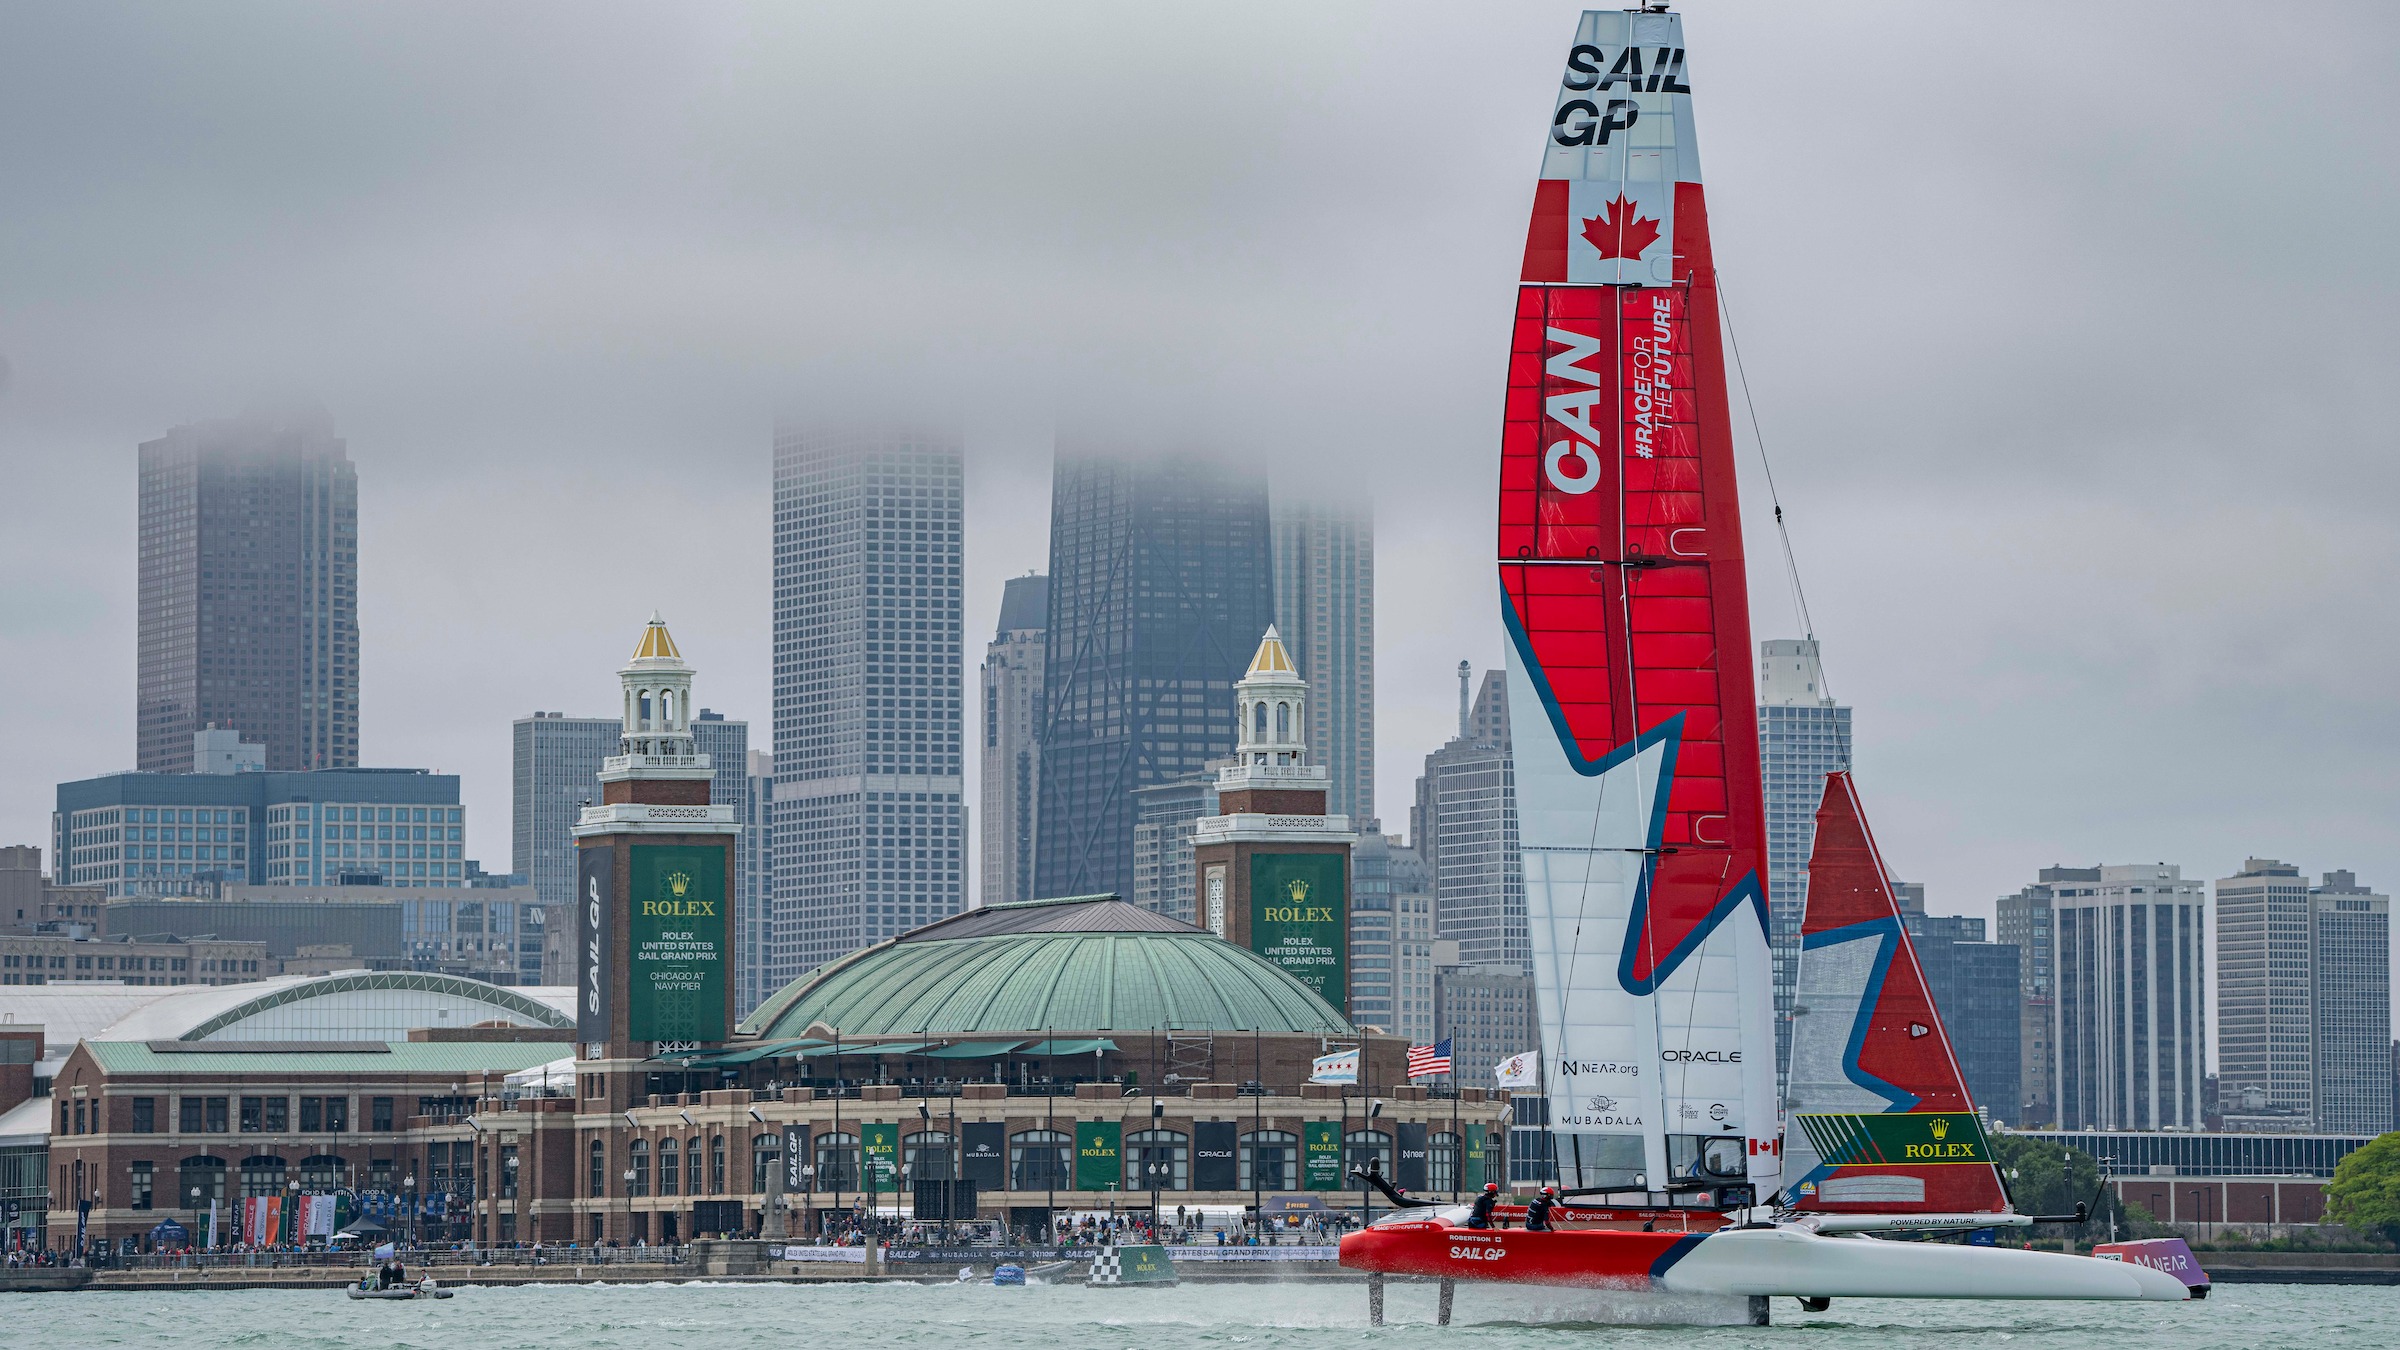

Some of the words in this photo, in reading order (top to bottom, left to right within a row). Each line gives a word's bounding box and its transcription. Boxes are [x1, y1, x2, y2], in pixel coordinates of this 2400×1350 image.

[1563, 44, 1690, 94] SAIL
[1551, 99, 1640, 146] GP
[1652, 296, 1673, 431] THEFUTURE
[1634, 336, 1653, 459] #RACEFOR
[1544, 326, 1600, 494] CAN
[589, 875, 600, 930] GP
[642, 901, 715, 916] ROLEX
[1264, 907, 1334, 922] ROLEX
[662, 932, 694, 940] ROLEX
[642, 942, 676, 950] UNITED
[678, 942, 713, 950] STATES
[638, 952, 659, 960] SAIL
[661, 952, 694, 960] GRAND
[695, 952, 717, 960] PRIX
[589, 934, 600, 1016] SAIL
[650, 972, 691, 980] CHICAGO
[693, 972, 705, 980] AT
[655, 982, 680, 990] NAVY
[681, 982, 700, 990] PIER
[1662, 1050, 1742, 1062] ORACLE
[1582, 1063, 1638, 1076] NEAR.org
[1562, 1116, 1642, 1126] MUBADALA
[790, 1132, 797, 1153] GP
[1082, 1148, 1115, 1156] ROLEX
[1906, 1144, 1975, 1158] ROLEX
[247, 1204, 255, 1237] ORACLE
[1576, 1212, 1613, 1220] cognizant
[1449, 1246, 1482, 1260] SAIL
[1484, 1248, 1506, 1260] GP
[2154, 1255, 2188, 1272] NEAR
